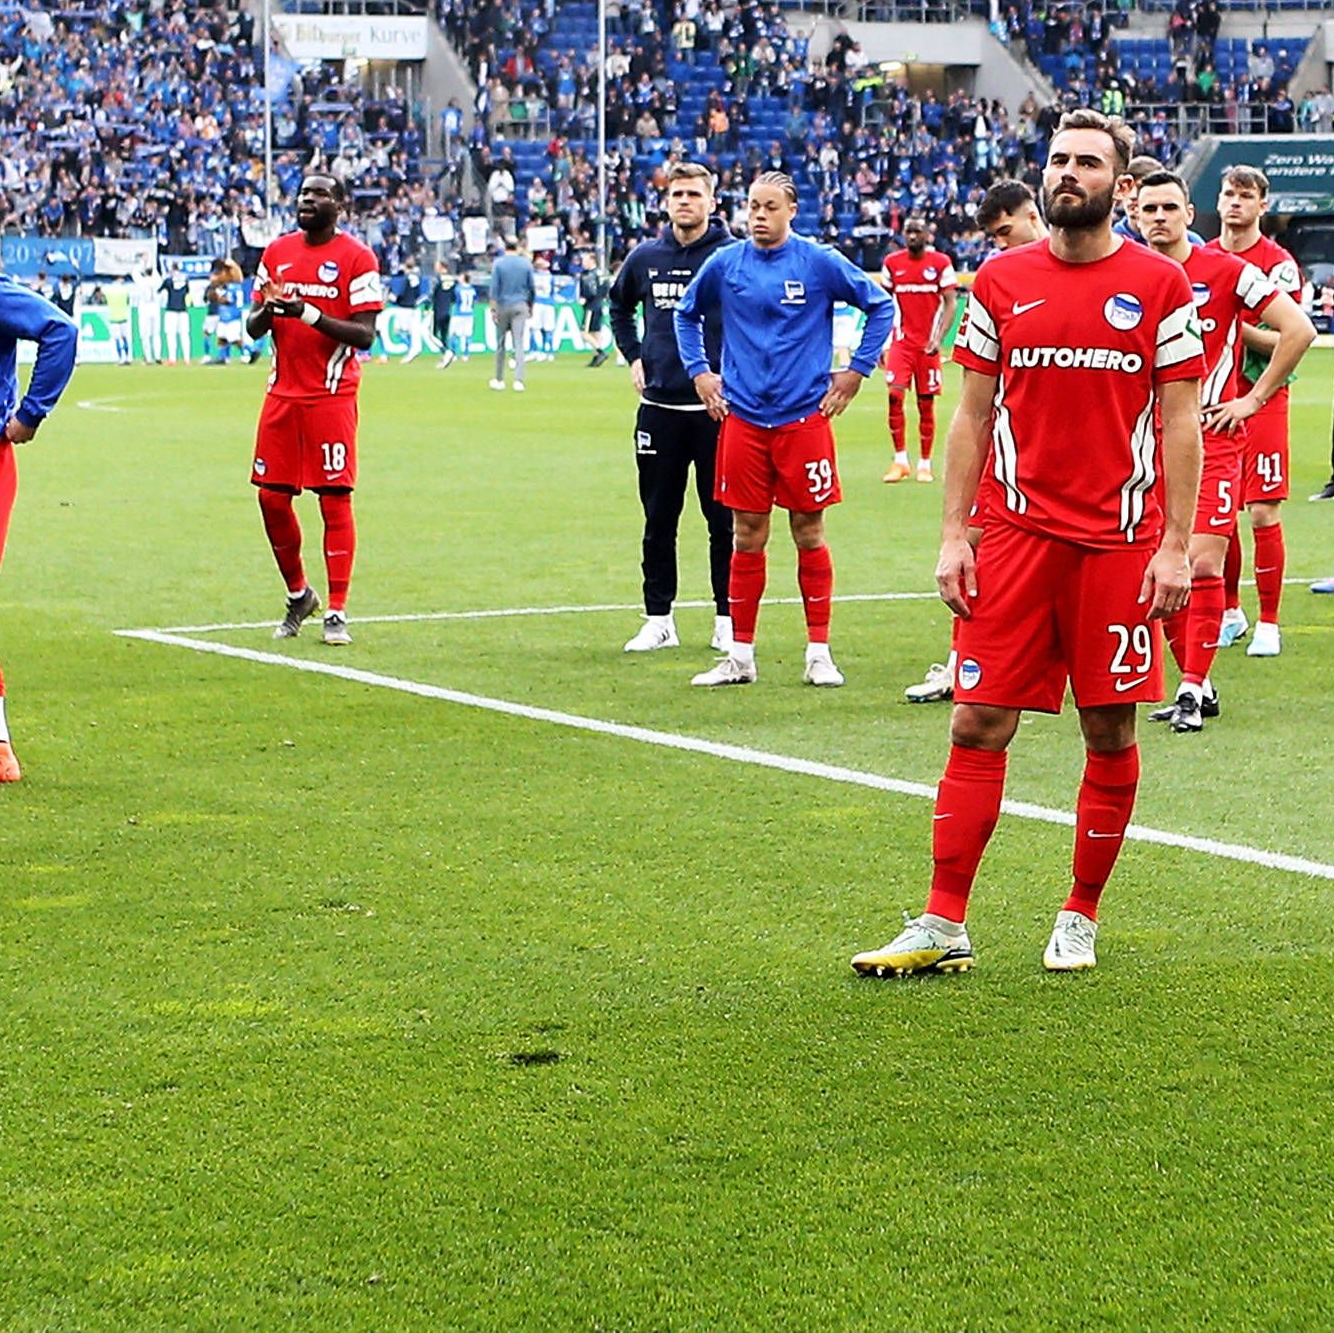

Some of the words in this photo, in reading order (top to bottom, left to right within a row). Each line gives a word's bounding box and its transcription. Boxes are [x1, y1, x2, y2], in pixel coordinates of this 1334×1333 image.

[370, 24, 421, 43] Kurve
[1264, 154, 1303, 165] Zero
[1267, 166, 1326, 176] andere
[1010, 347, 1143, 374] AUTOHERO
[321, 442, 346, 472] 18
[1256, 452, 1283, 483] 41
[805, 458, 832, 493] 39
[1217, 480, 1233, 514] 5
[1108, 624, 1153, 674] 29
